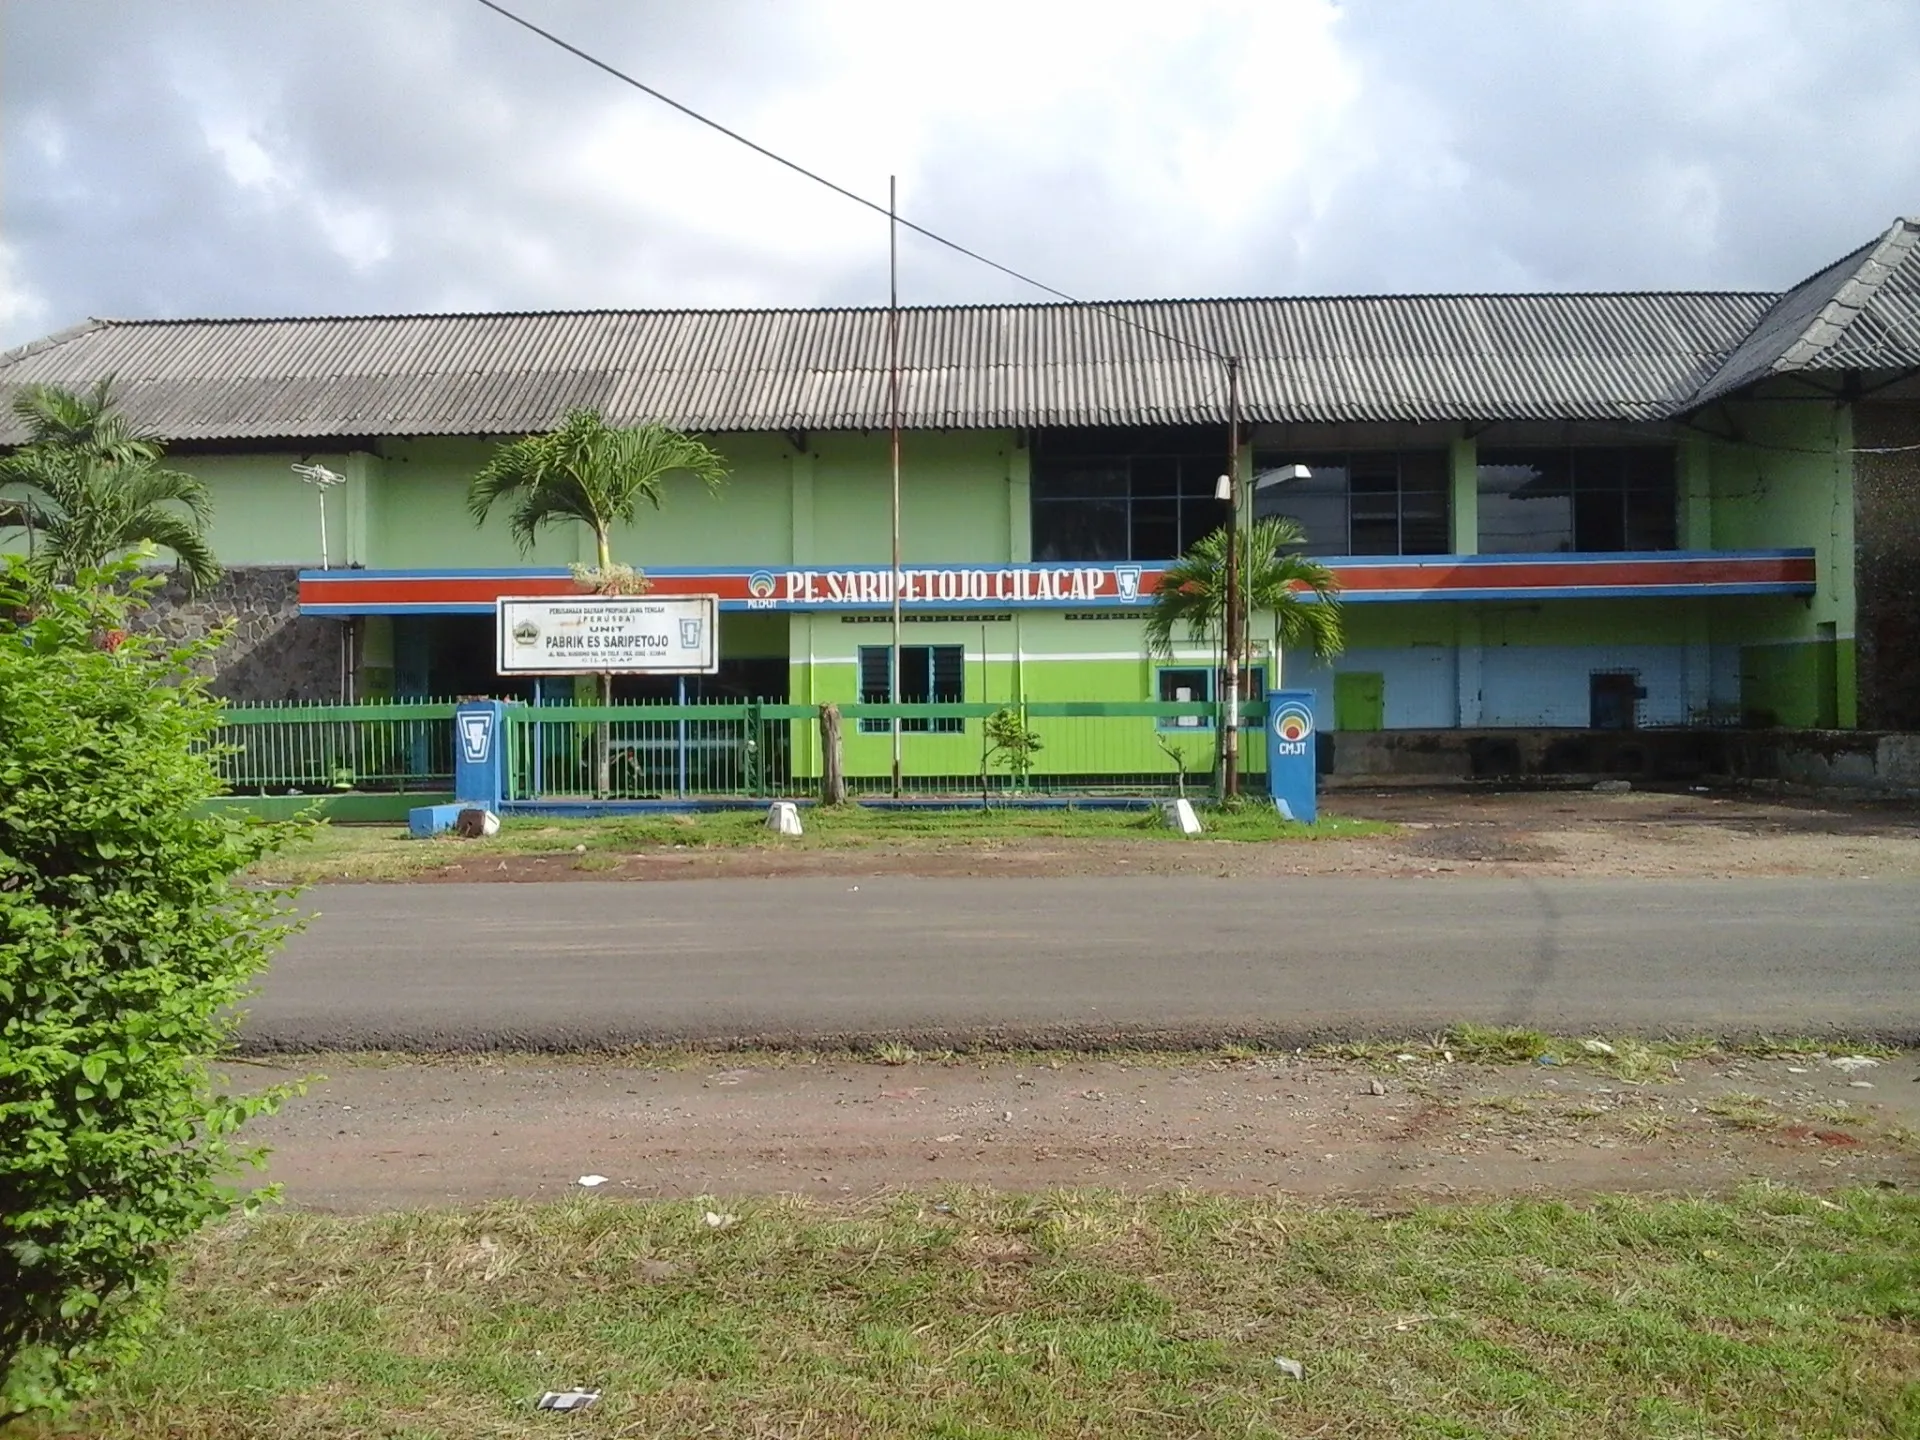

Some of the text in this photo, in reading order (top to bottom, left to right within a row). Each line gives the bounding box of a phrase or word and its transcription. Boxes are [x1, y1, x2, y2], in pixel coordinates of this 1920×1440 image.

[995, 568, 1105, 600] CILACAP
[589, 625, 625, 633] UNIT
[546, 635, 669, 648] PABRIK ES SARIPETOJO
[1279, 742, 1307, 756] CMJT
